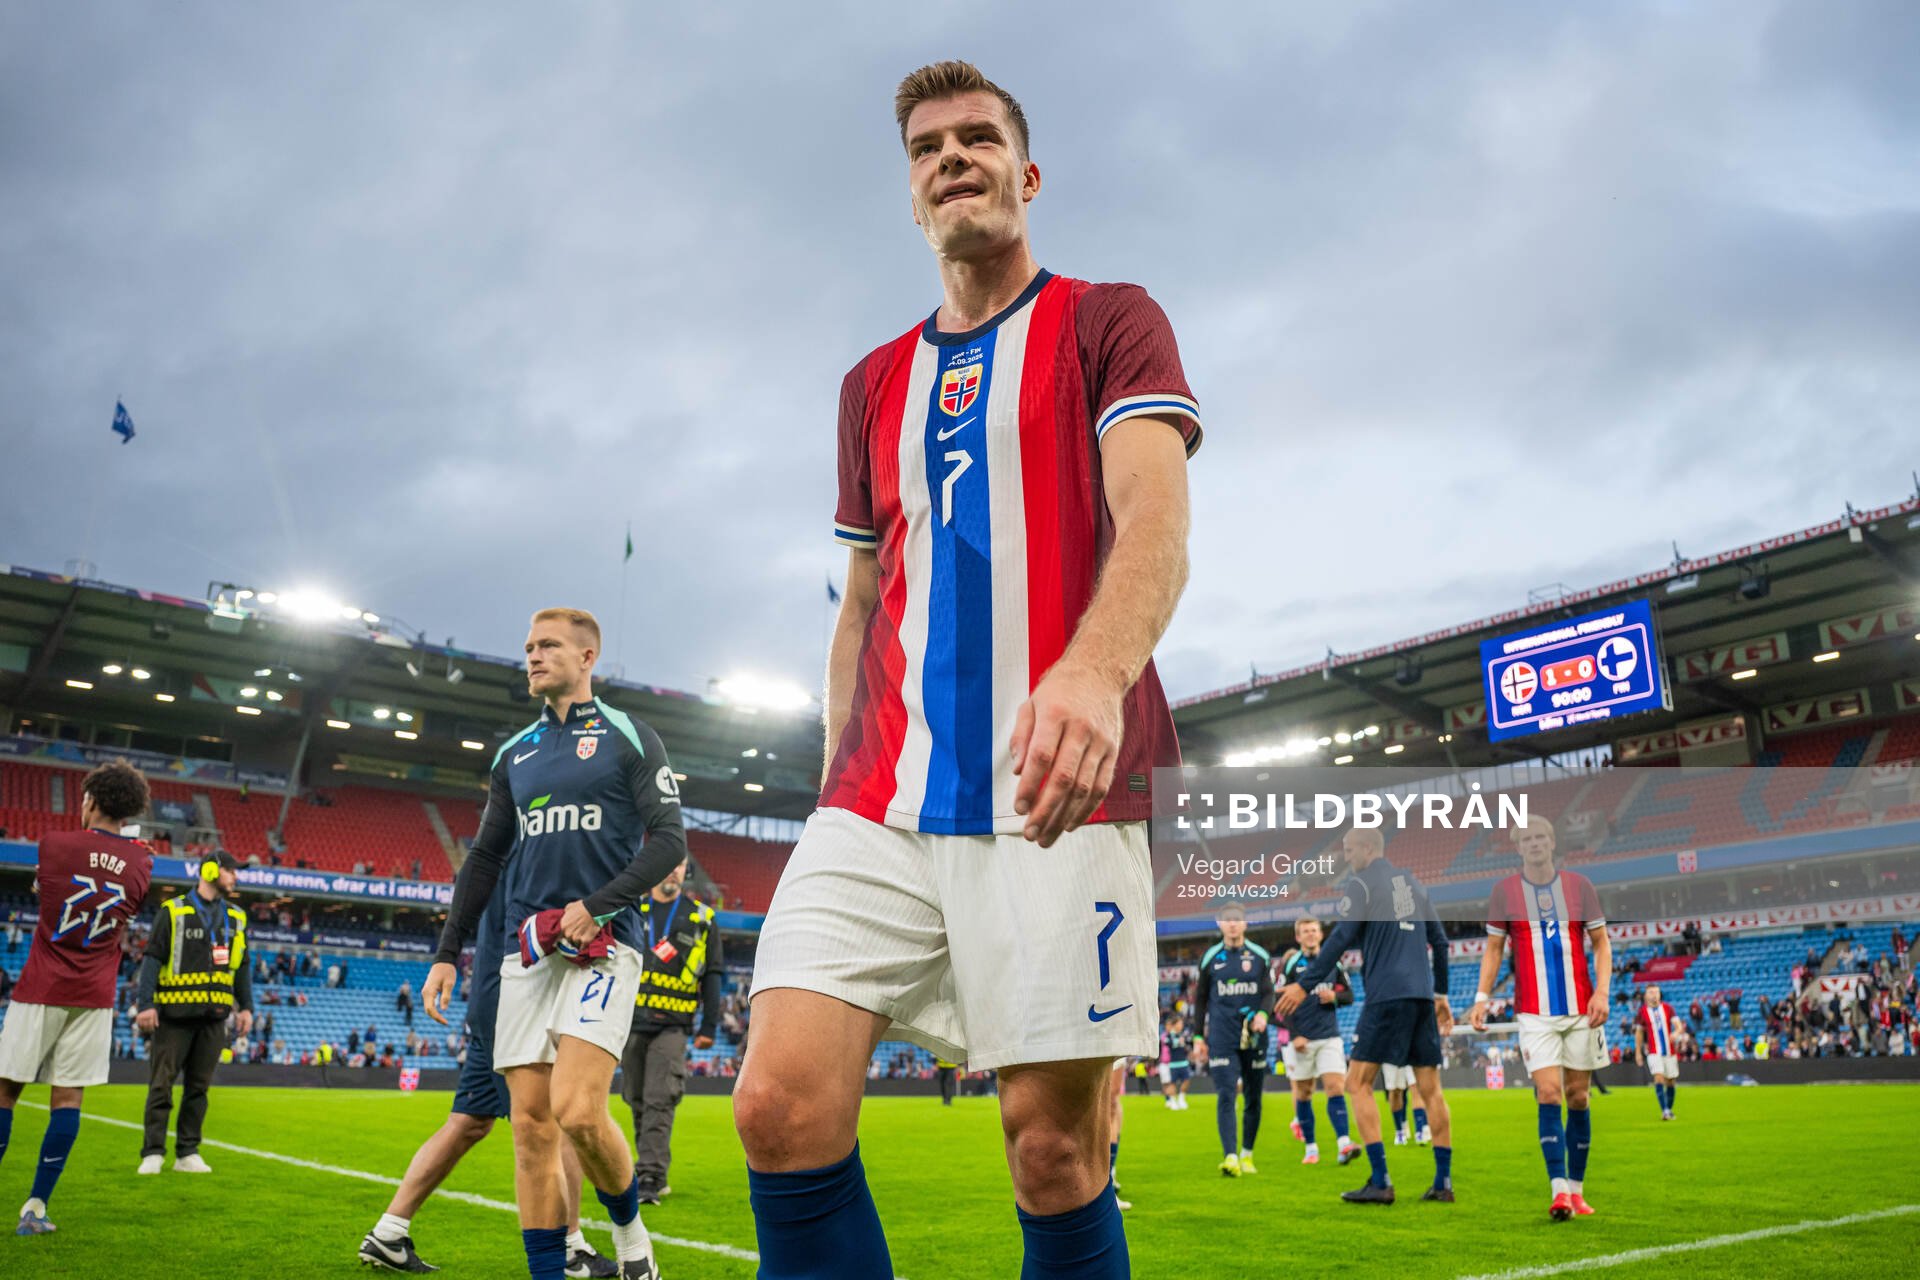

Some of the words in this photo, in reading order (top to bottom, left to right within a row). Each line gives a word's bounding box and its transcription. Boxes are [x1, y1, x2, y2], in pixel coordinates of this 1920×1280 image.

[970, 346, 982, 355] FIN
[942, 449, 973, 528] 7
[1503, 626, 1578, 654] INTERNATIONAL
[1577, 613, 1625, 635] FRIENDLY
[1685, 638, 1779, 679] VG
[1544, 668, 1557, 686] 1
[1578, 660, 1592, 678] 0
[1551, 687, 1592, 708] 90:00
[1768, 692, 1865, 730] VG
[1452, 704, 1488, 729] V
[1680, 724, 1745, 748] VG
[89, 852, 126, 875] BOBB
[236, 869, 274, 885] este
[277, 875, 329, 892] menn,
[333, 877, 366, 893] drar
[369, 882, 387, 896] ut
[389, 881, 394, 896] i
[397, 883, 432, 899] strid
[50, 874, 126, 947] 22
[1711, 913, 1758, 929] VG
[1769, 905, 1818, 924] VG
[1095, 901, 1125, 991] 7
[580, 969, 615, 1011] 21
[1217, 980, 1258, 997] bama
